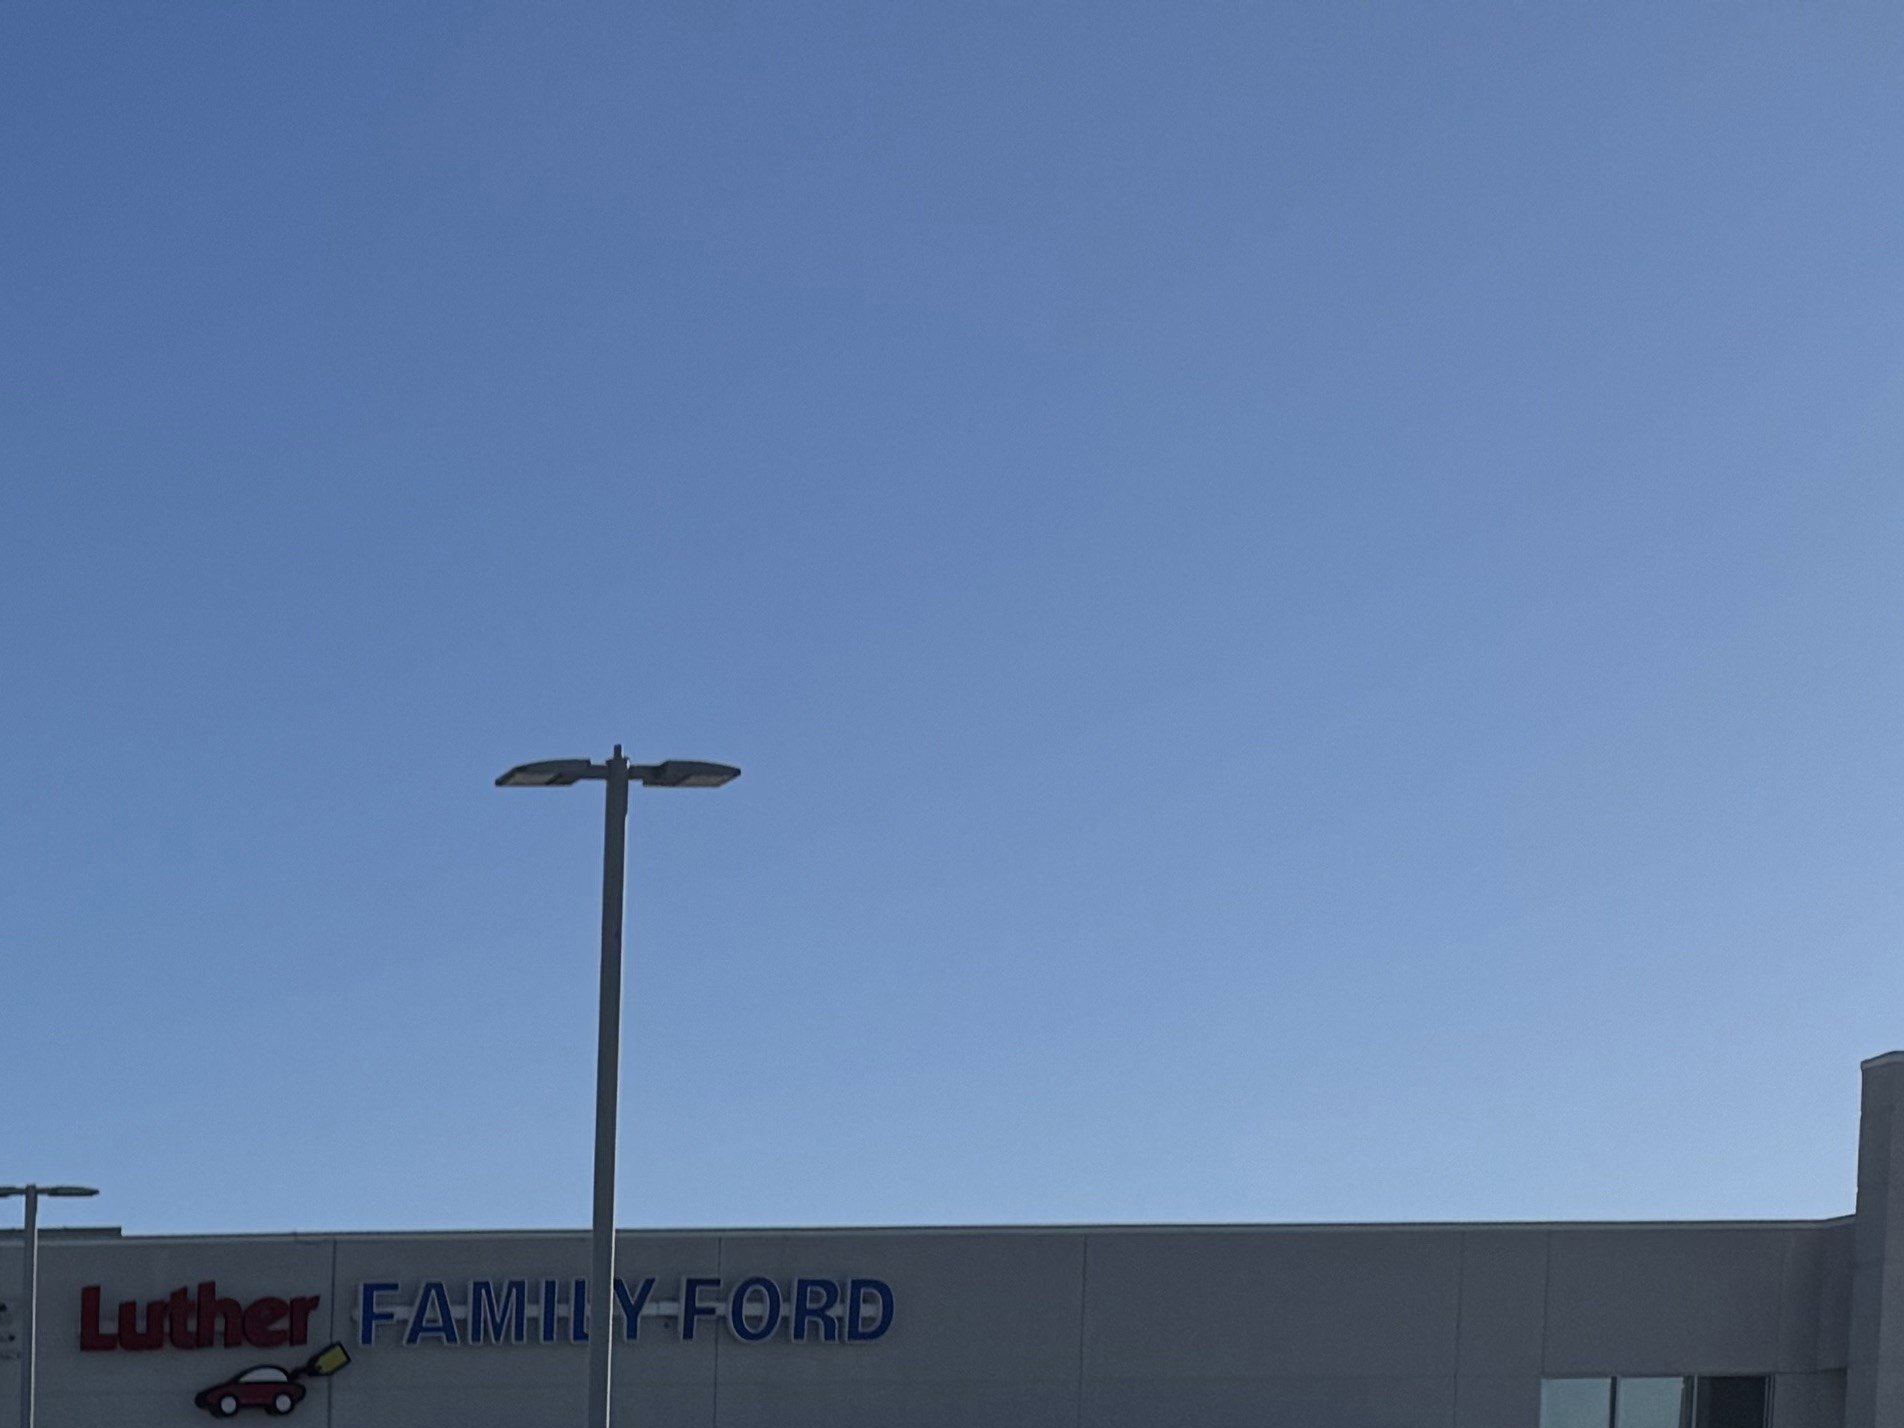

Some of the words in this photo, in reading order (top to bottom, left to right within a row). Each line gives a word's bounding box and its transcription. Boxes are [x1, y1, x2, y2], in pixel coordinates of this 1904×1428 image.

[79, 1280, 321, 1352] Luther
[358, 1277, 657, 1345] FAMILY
[680, 1275, 895, 1343] FORD
